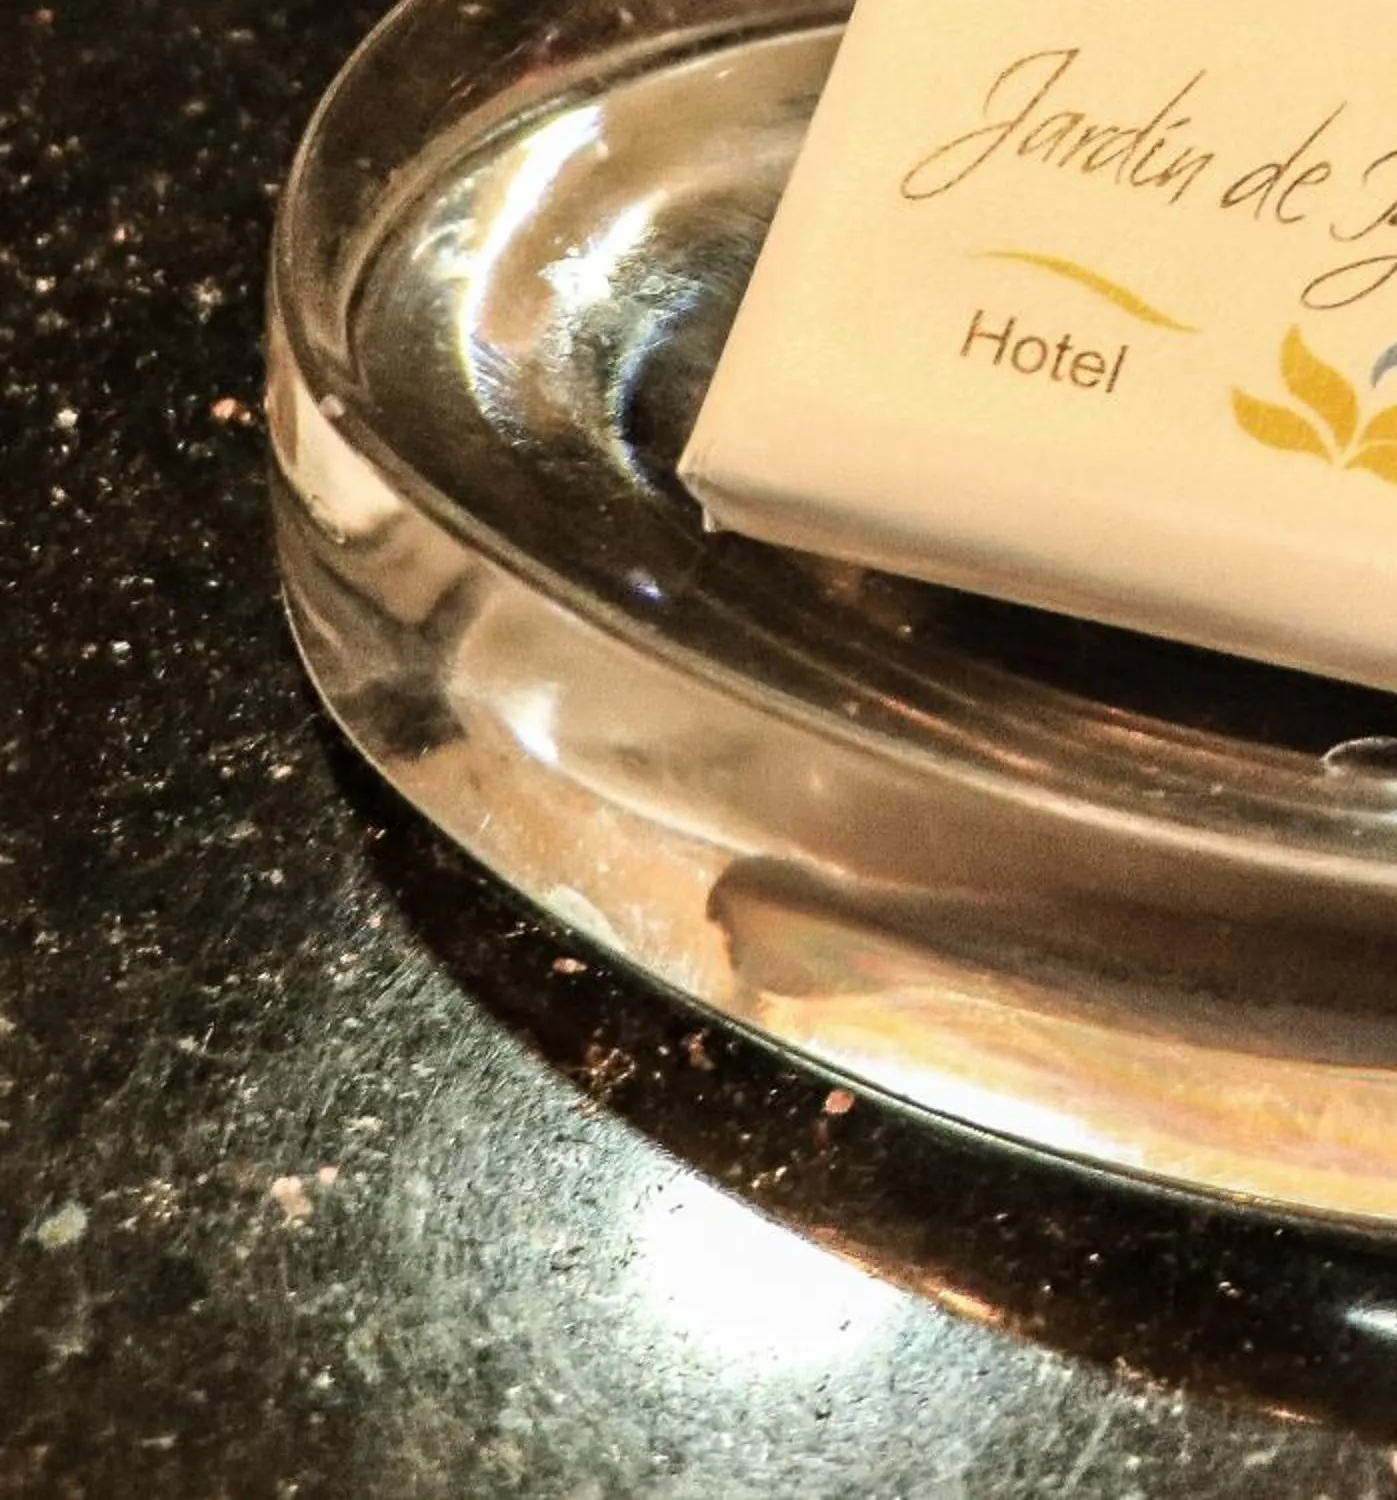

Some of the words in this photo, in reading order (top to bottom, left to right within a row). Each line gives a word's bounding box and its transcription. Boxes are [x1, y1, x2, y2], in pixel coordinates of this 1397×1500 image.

[900, 47, 1216, 204] Jardín
[1220, 101, 1348, 224] de
[959, 308, 1129, 395] Hotel
